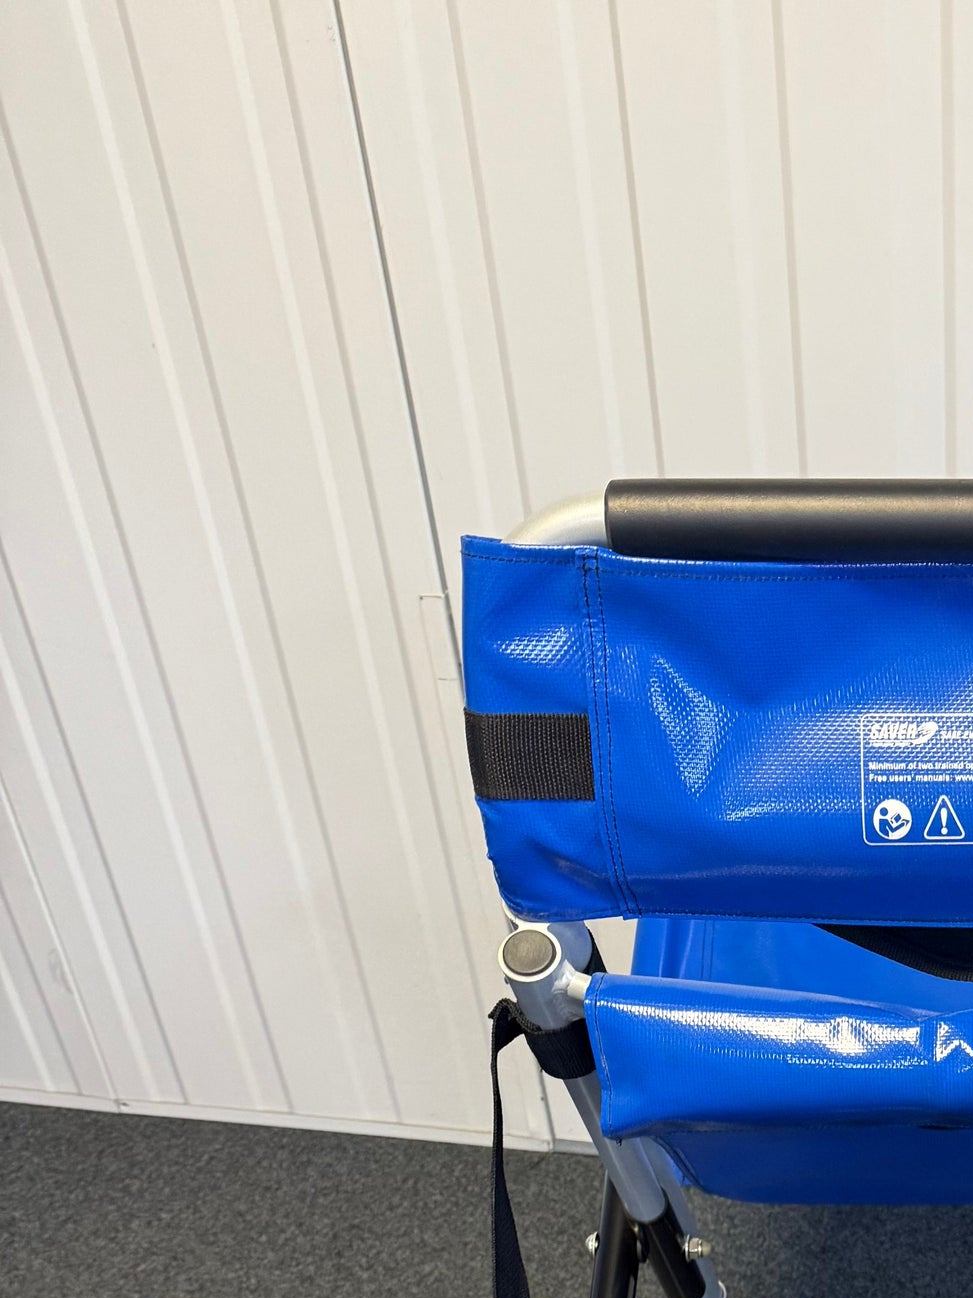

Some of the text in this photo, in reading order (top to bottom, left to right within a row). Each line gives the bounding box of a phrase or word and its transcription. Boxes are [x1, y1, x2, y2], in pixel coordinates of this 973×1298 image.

[869, 722, 918, 740] SAVER
[868, 761, 906, 770] Minimum
[907, 761, 918, 770] of
[919, 761, 934, 770] two
[934, 761, 964, 770] trained
[868, 774, 888, 782] Free
[889, 774, 914, 782] users'
[915, 774, 954, 782] manuals:
